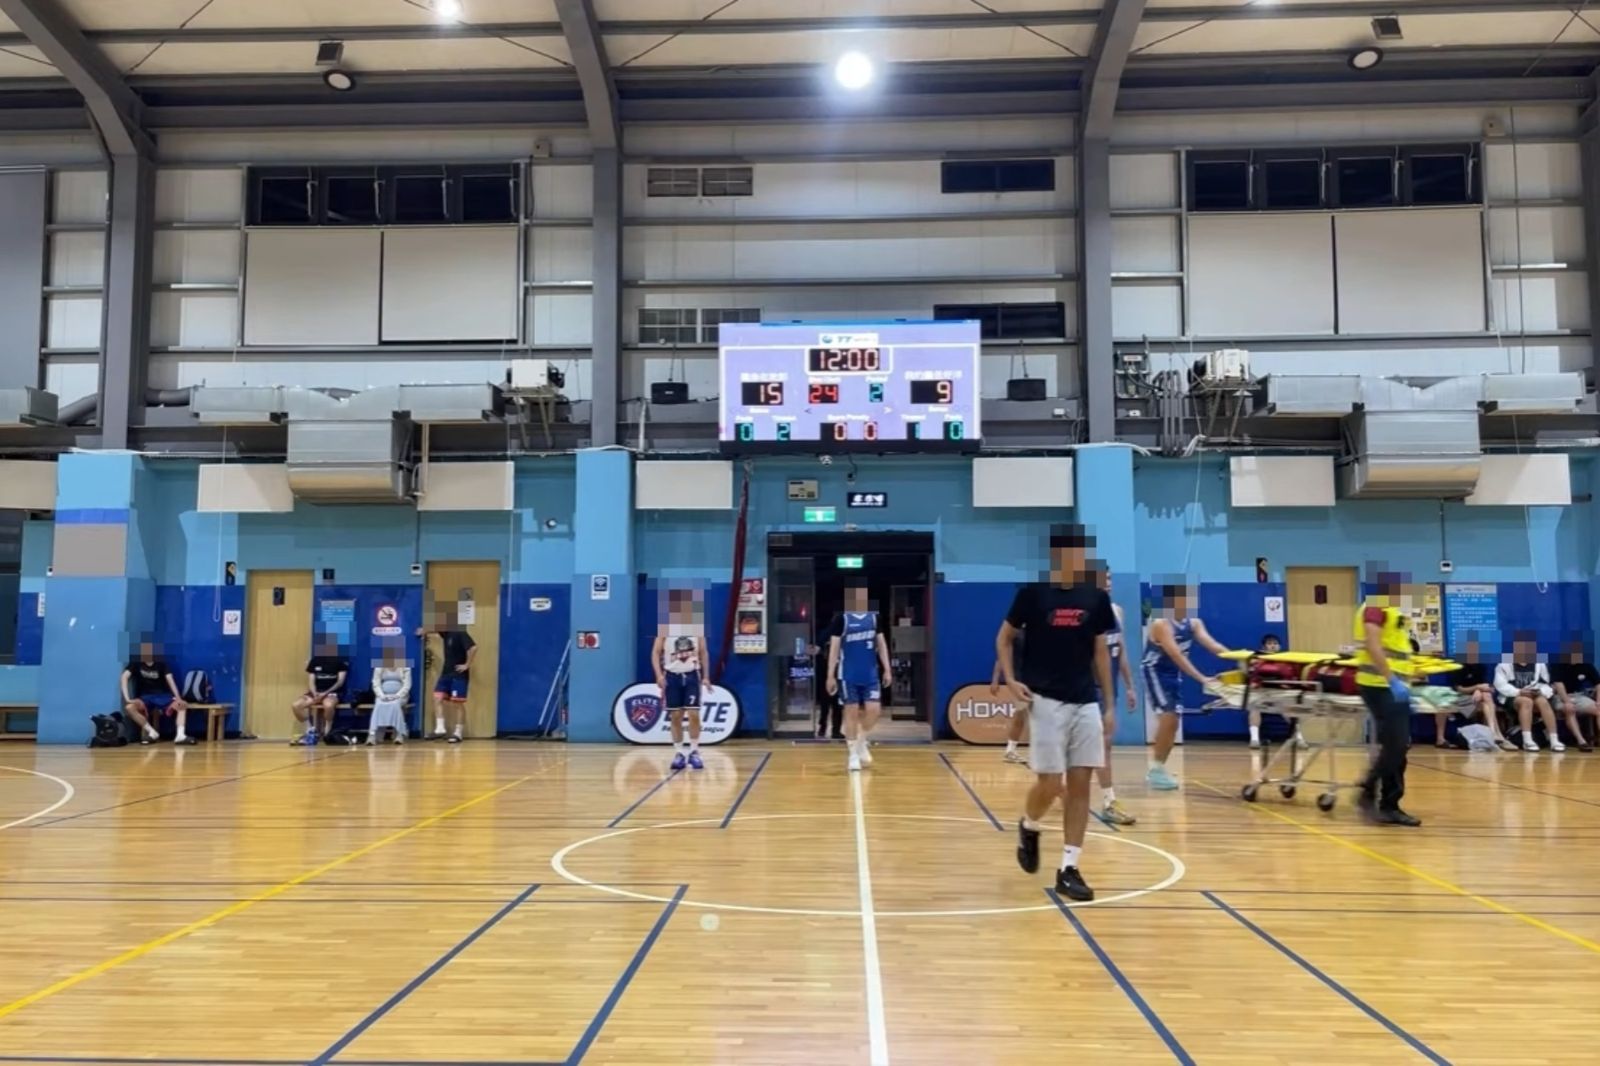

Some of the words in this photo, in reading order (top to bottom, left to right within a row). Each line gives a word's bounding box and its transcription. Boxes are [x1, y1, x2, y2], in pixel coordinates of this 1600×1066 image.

[820, 348, 878, 370] 12:00
[760, 383, 782, 404] 15
[809, 384, 837, 403] 24
[869, 384, 883, 402] 2
[937, 381, 951, 402] 9
[740, 423, 753, 440] 0
[776, 423, 790, 440] 2
[834, 422, 847, 440] 0
[864, 421, 877, 440] 0
[950, 421, 963, 440] 0
[631, 698, 658, 706] ELITE
[689, 695, 696, 705] 7
[664, 702, 731, 723] ETE
